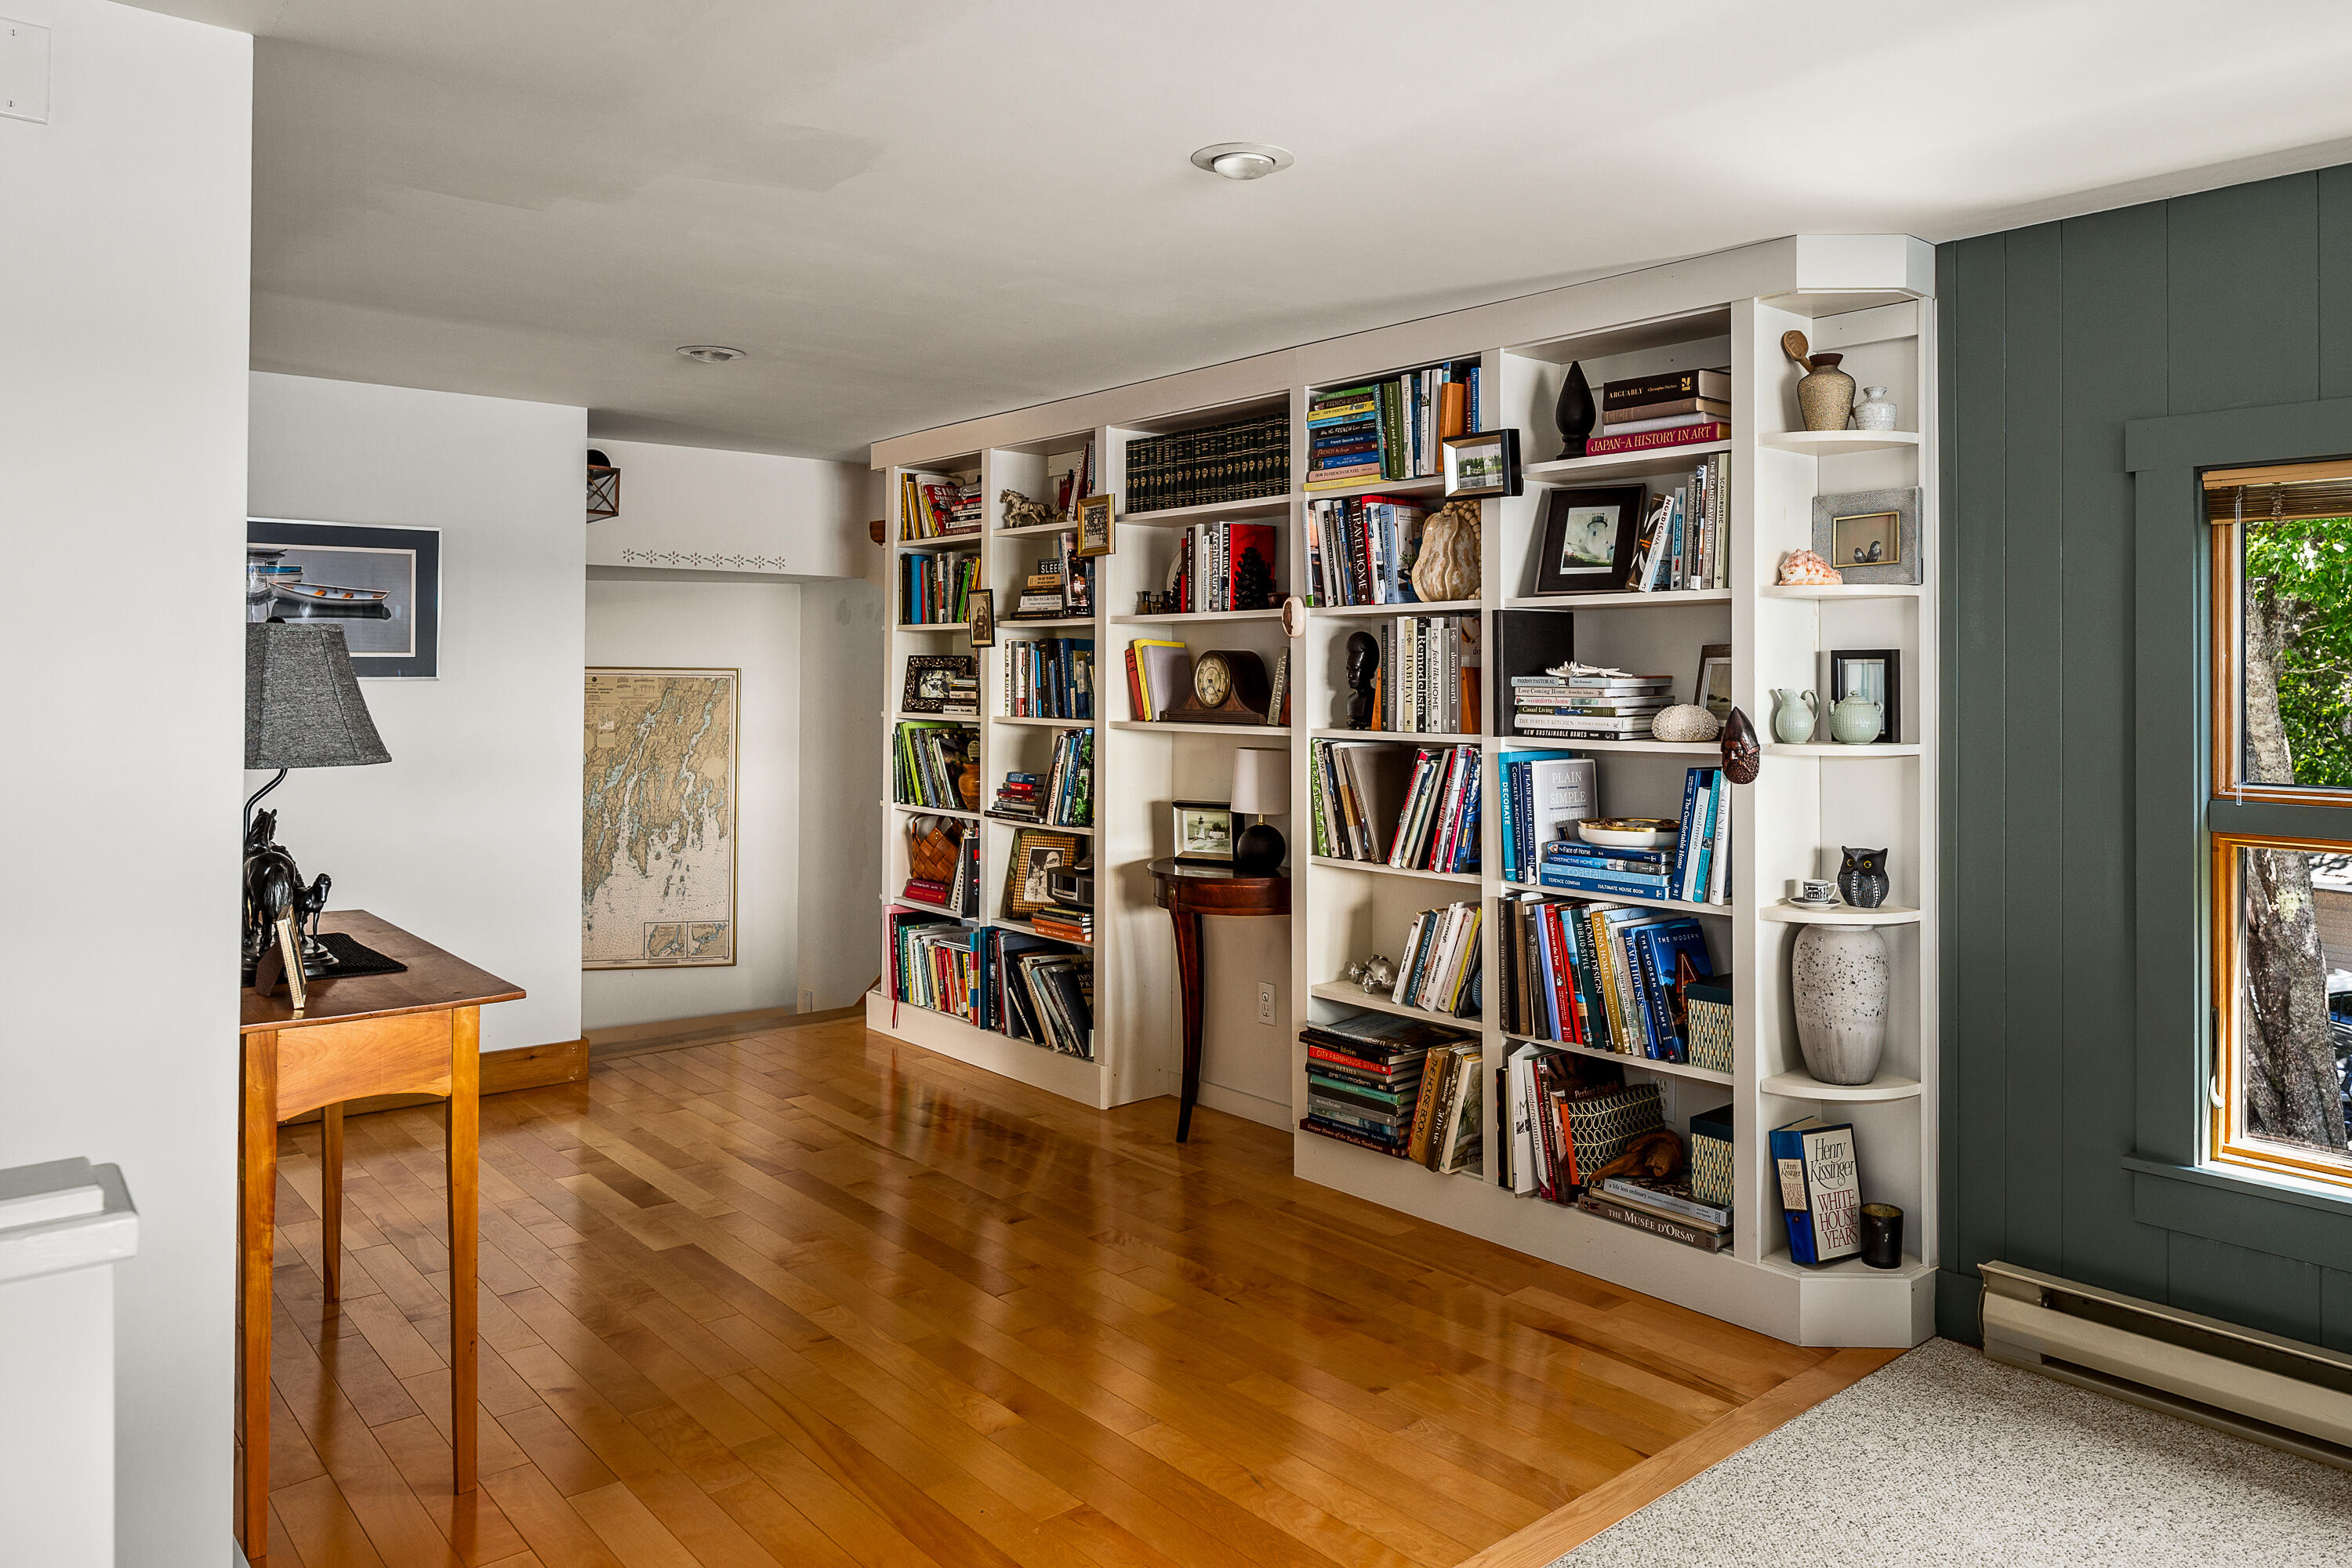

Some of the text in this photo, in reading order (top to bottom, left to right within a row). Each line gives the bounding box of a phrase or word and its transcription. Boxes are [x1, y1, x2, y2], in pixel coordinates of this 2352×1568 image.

[1609, 388, 1642, 398] ARGUABLY
[1635, 431, 1676, 446] HISTORY
[1678, 430, 1690, 441] IN
[1691, 426, 1711, 439] ART
[1689, 509, 1694, 519] TO
[1707, 474, 1715, 530] SCANDINAVIAN
[1352, 512, 1364, 551] TRAVEL
[1654, 499, 1671, 546] NORDICANA
[1356, 553, 1367, 590] HOME
[1277, 661, 1286, 690] LITTLE
[1417, 635, 1426, 717] Remodelista
[1552, 771, 1582, 783] PLAIN
[1049, 782, 1058, 811] SCOTLAND
[1550, 791, 1586, 804] SIMPLE
[1706, 777, 1720, 833] COASTAL BLUES
[1679, 811, 1690, 848] Comfortable
[1568, 867, 1642, 884] coastal modern
[1443, 926, 1451, 943] enough
[1577, 923, 1589, 970] BIBLIO-STYLE
[1584, 920, 1595, 948] HOME
[1592, 960, 1602, 993] DESIGN
[1411, 974, 1420, 993] FUNNY?
[1625, 937, 1644, 1007] BEACH HOUSES
[1646, 954, 1657, 988] MODERN
[1654, 992, 1667, 1028] A-FRAME
[1330, 1051, 1362, 1067] FARMHOUSE
[1363, 1062, 1379, 1071] STYLE
[1336, 1066, 1356, 1075] DETAILS
[1328, 1072, 1371, 1087] prefabmodern
[1422, 1078, 1434, 1109] HOUSE
[1417, 1109, 1428, 1134] BOOK
[1547, 1122, 1555, 1151] Farmhouse
[1815, 1138, 1847, 1163] Henry
[1780, 1169, 1802, 1179] Kissinger
[1784, 1162, 1797, 1172] Henry
[1809, 1160, 1854, 1190] Kissinger
[1629, 1188, 1647, 1199] ordinary
[1782, 1183, 1803, 1192] WHITE
[1784, 1190, 1804, 1200] HOUSE
[1786, 1197, 1805, 1207] YEARS
[1817, 1189, 1855, 1213] WHITE
[1608, 1209, 1621, 1219] THE
[1624, 1210, 1656, 1230] MUSÉE
[1819, 1207, 1858, 1232] HOUSE
[1824, 1225, 1858, 1250] YEARS
